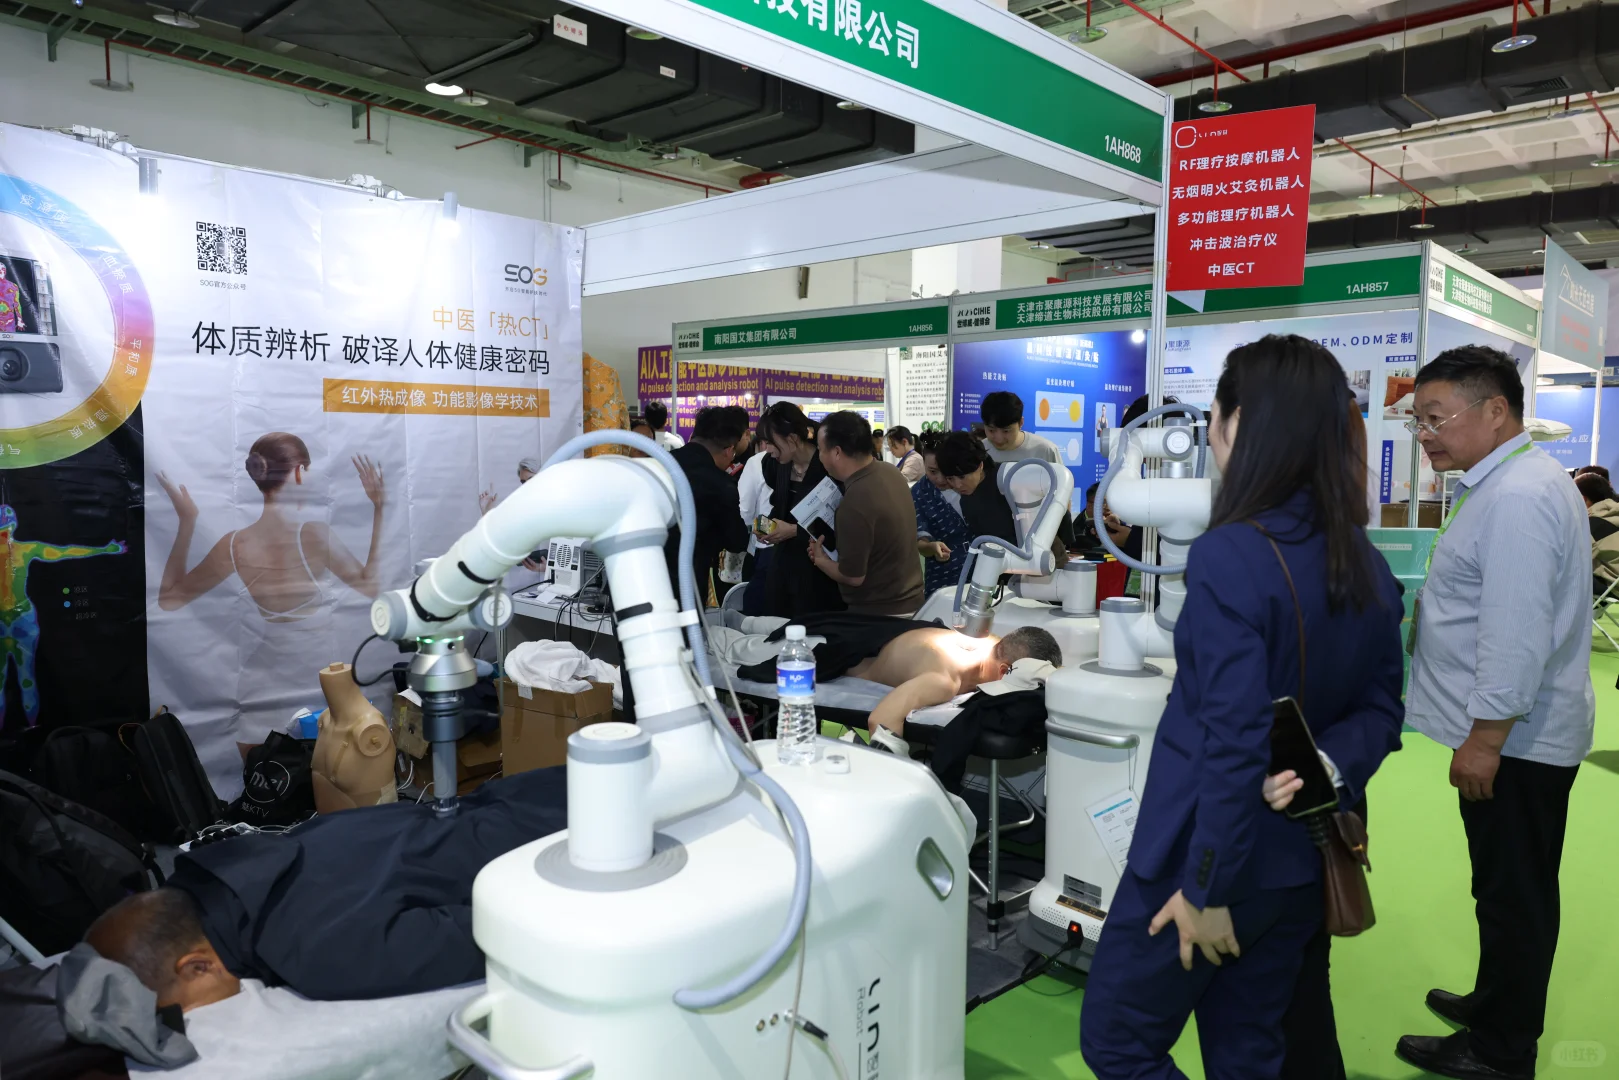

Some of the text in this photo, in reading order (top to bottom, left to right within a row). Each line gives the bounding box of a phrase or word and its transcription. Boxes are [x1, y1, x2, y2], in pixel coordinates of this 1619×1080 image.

[1104, 135, 1142, 164] 1AH868
[1172, 175, 1305, 200] 无烟明火艾灸机器人
[1177, 204, 1295, 226] 多功能理疗机器人
[1189, 233, 1278, 251] 冲击波治疗仪
[1208, 262, 1255, 277] 中医CT
[199, 279, 247, 290] SOG官方公众号
[1346, 281, 1389, 295] 1AH857
[1017, 289, 1153, 314] 天津市聚康源科技发展有限公司
[713, 327, 797, 345] 南阳国艾集团有限公司
[908, 323, 933, 333] 1AH856
[125, 338, 142, 377] 平和质
[191, 320, 551, 375] 体质辨析 破译人体健康密码
[640, 378, 759, 395] AI pulse deection and analysis robot
[765, 378, 885, 397] AI pulse detection and analysis robo
[341, 385, 539, 411] 红外热成像 功能影像学技术
[68, 408, 110, 440] 湿热质
[855, 986, 866, 1038] Robot
